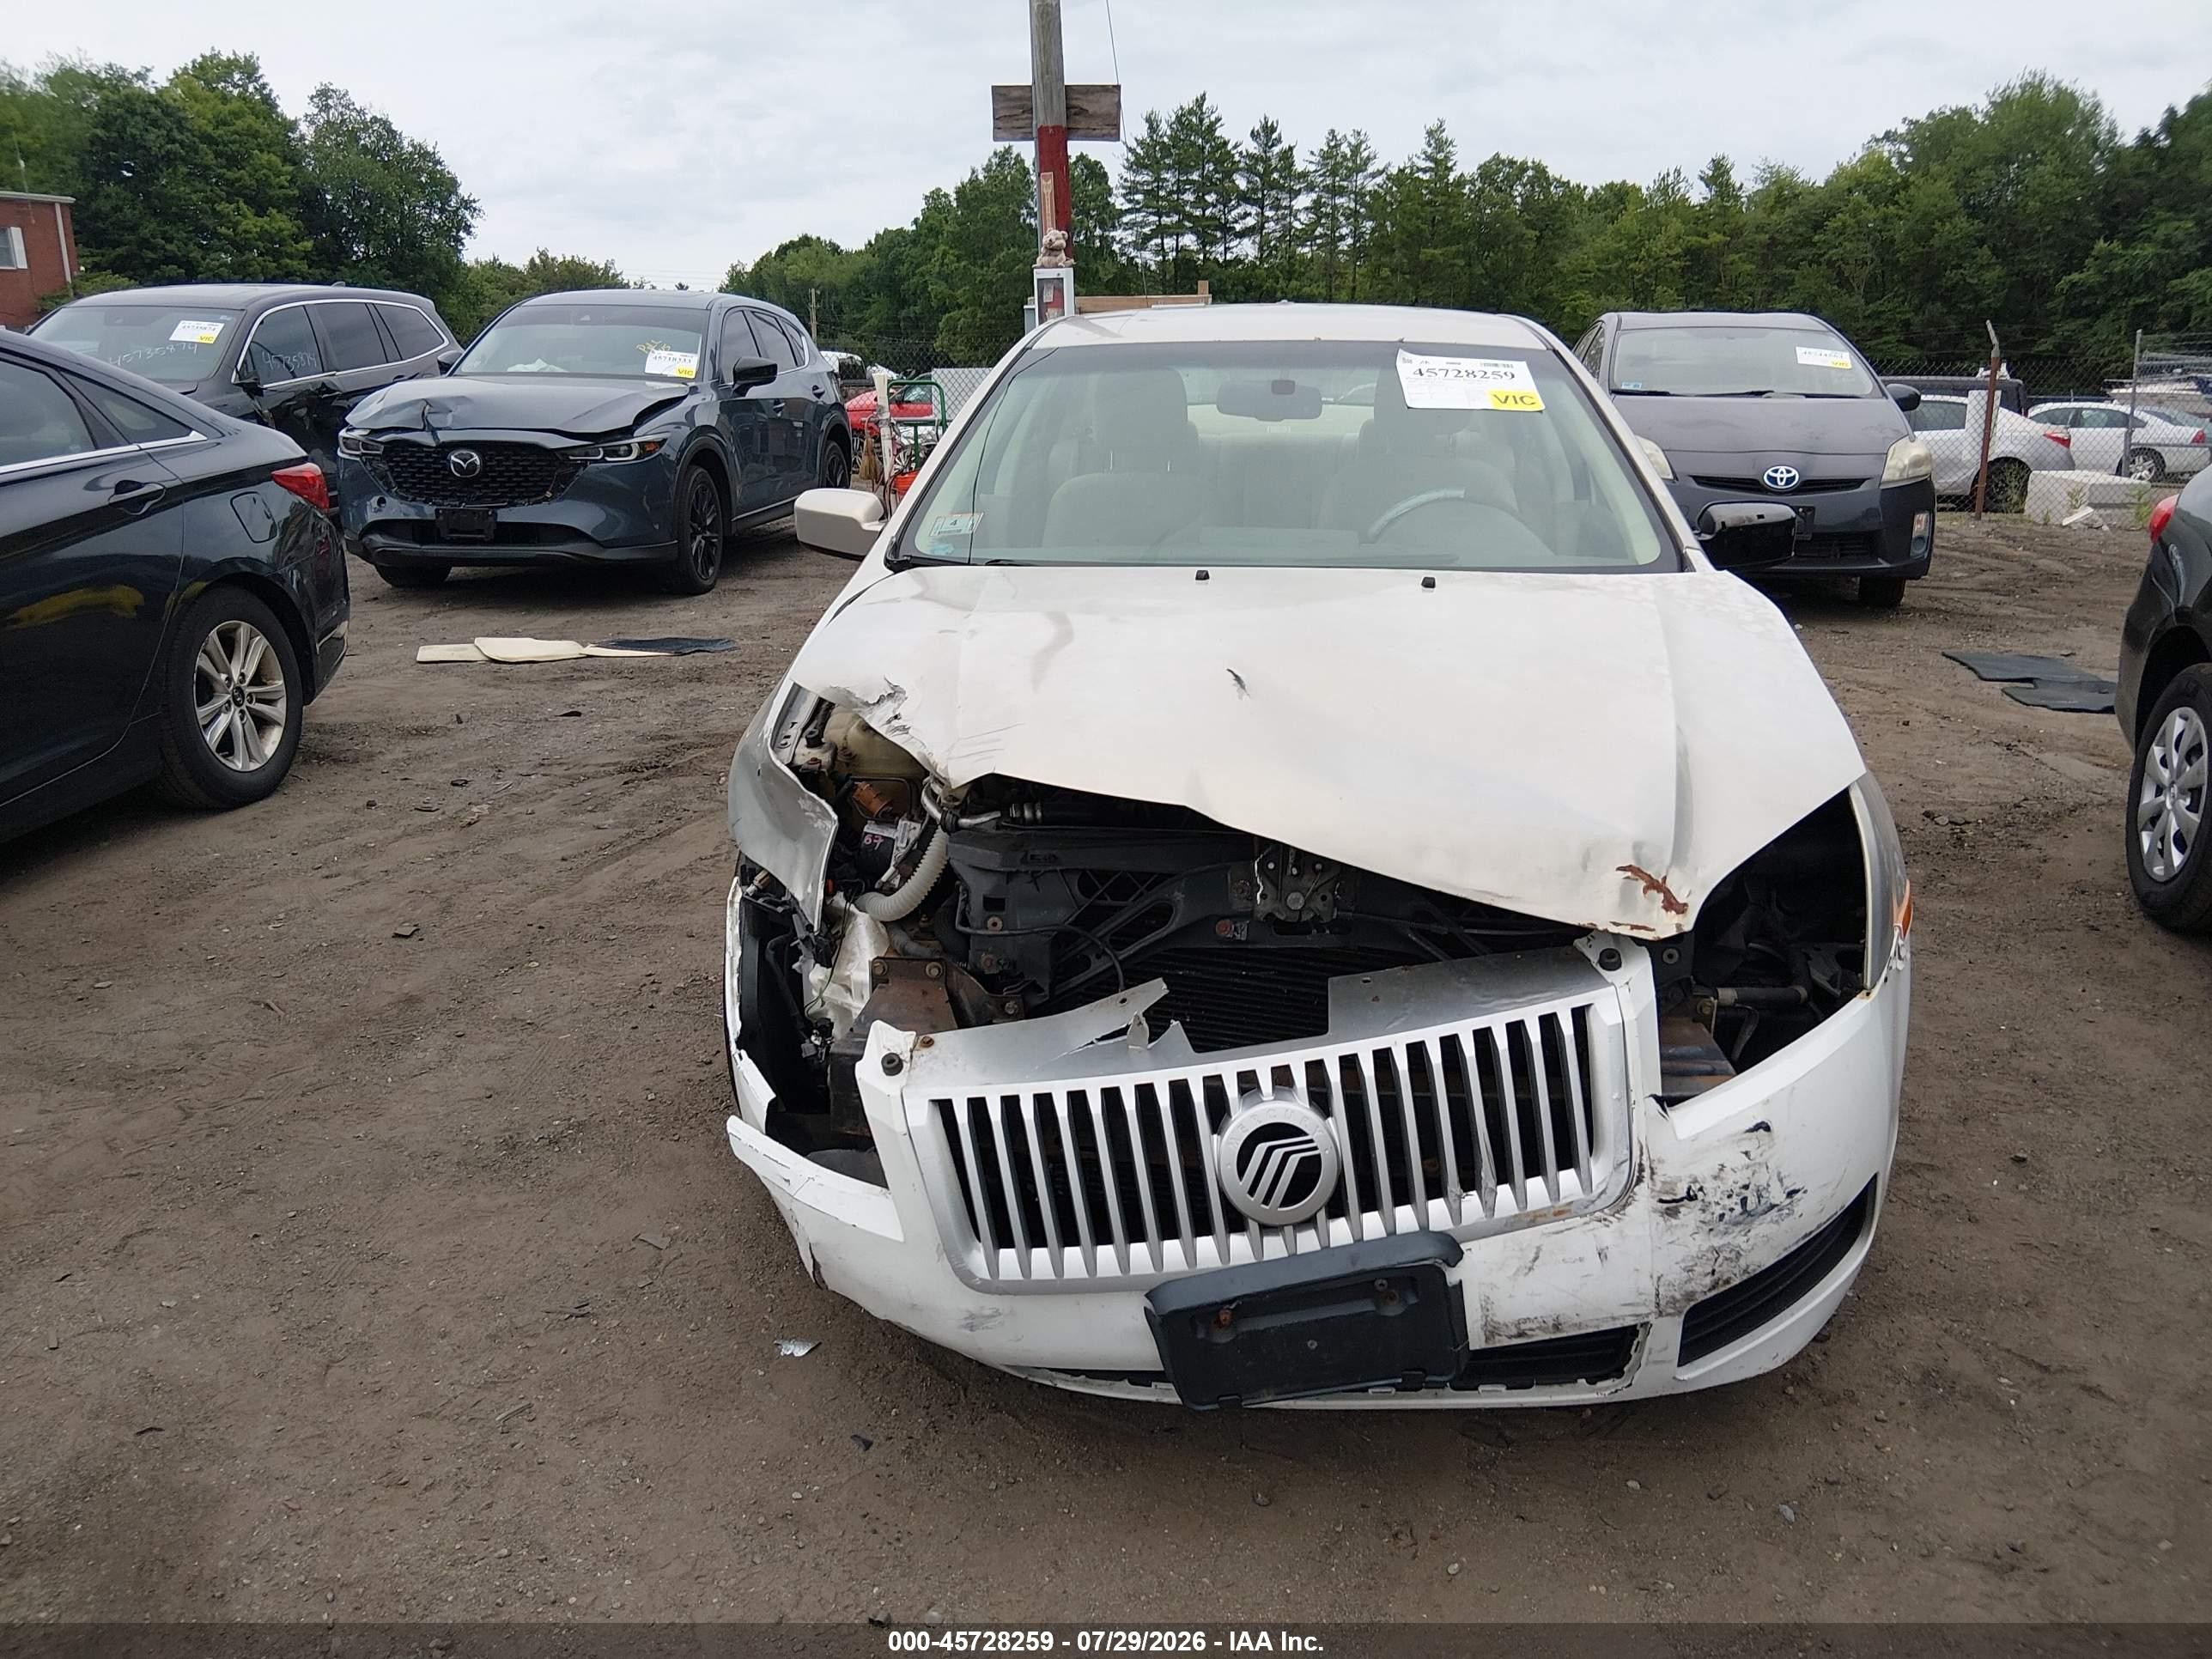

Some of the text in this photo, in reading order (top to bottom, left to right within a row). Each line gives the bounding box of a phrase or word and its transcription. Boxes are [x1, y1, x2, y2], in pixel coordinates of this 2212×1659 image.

[109, 343, 198, 366] 45735874
[1413, 368, 1516, 380] 45728259
[1492, 393, 1536, 406] VIC
[1228, 1108, 1324, 1149] MERCURY
